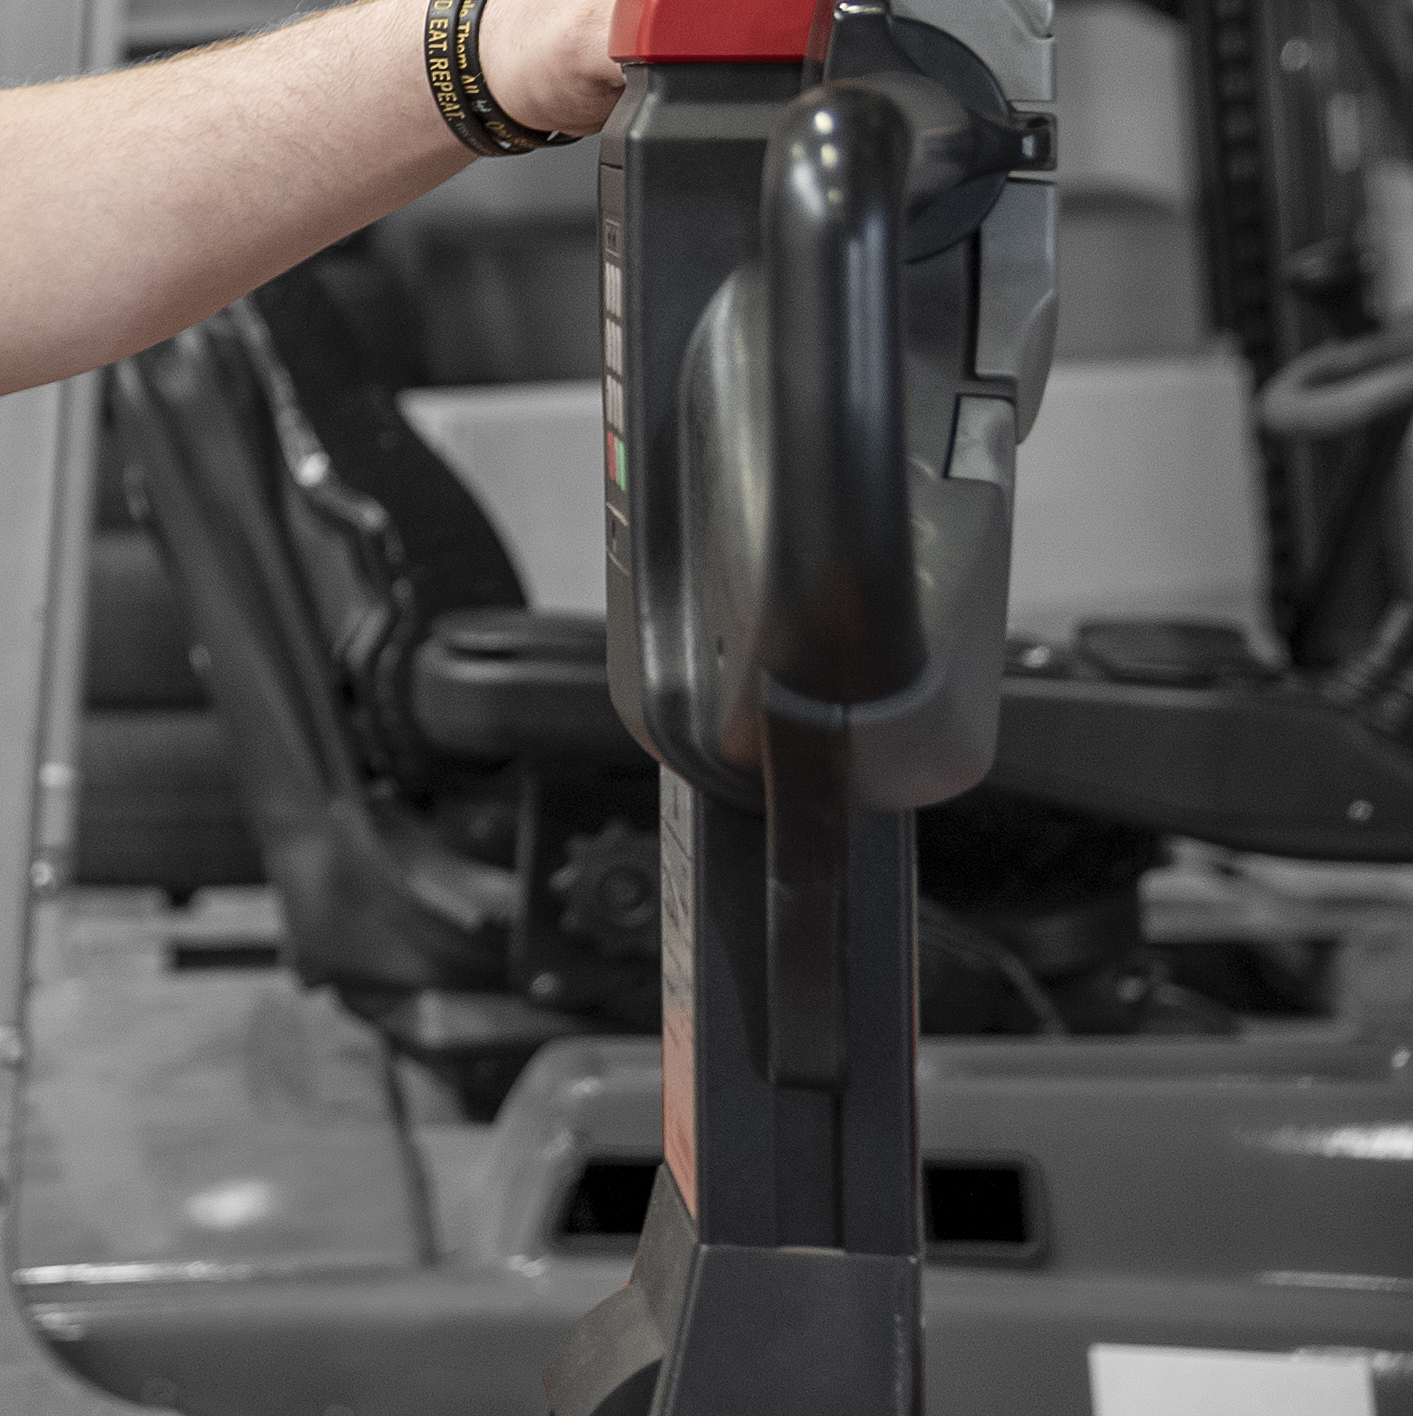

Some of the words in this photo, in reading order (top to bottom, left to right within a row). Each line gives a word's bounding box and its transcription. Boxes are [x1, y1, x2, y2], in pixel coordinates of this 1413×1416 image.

[428, 18, 449, 55] EAT.
[429, 58, 466, 121] REPEAT.
[461, 74, 480, 94] All
